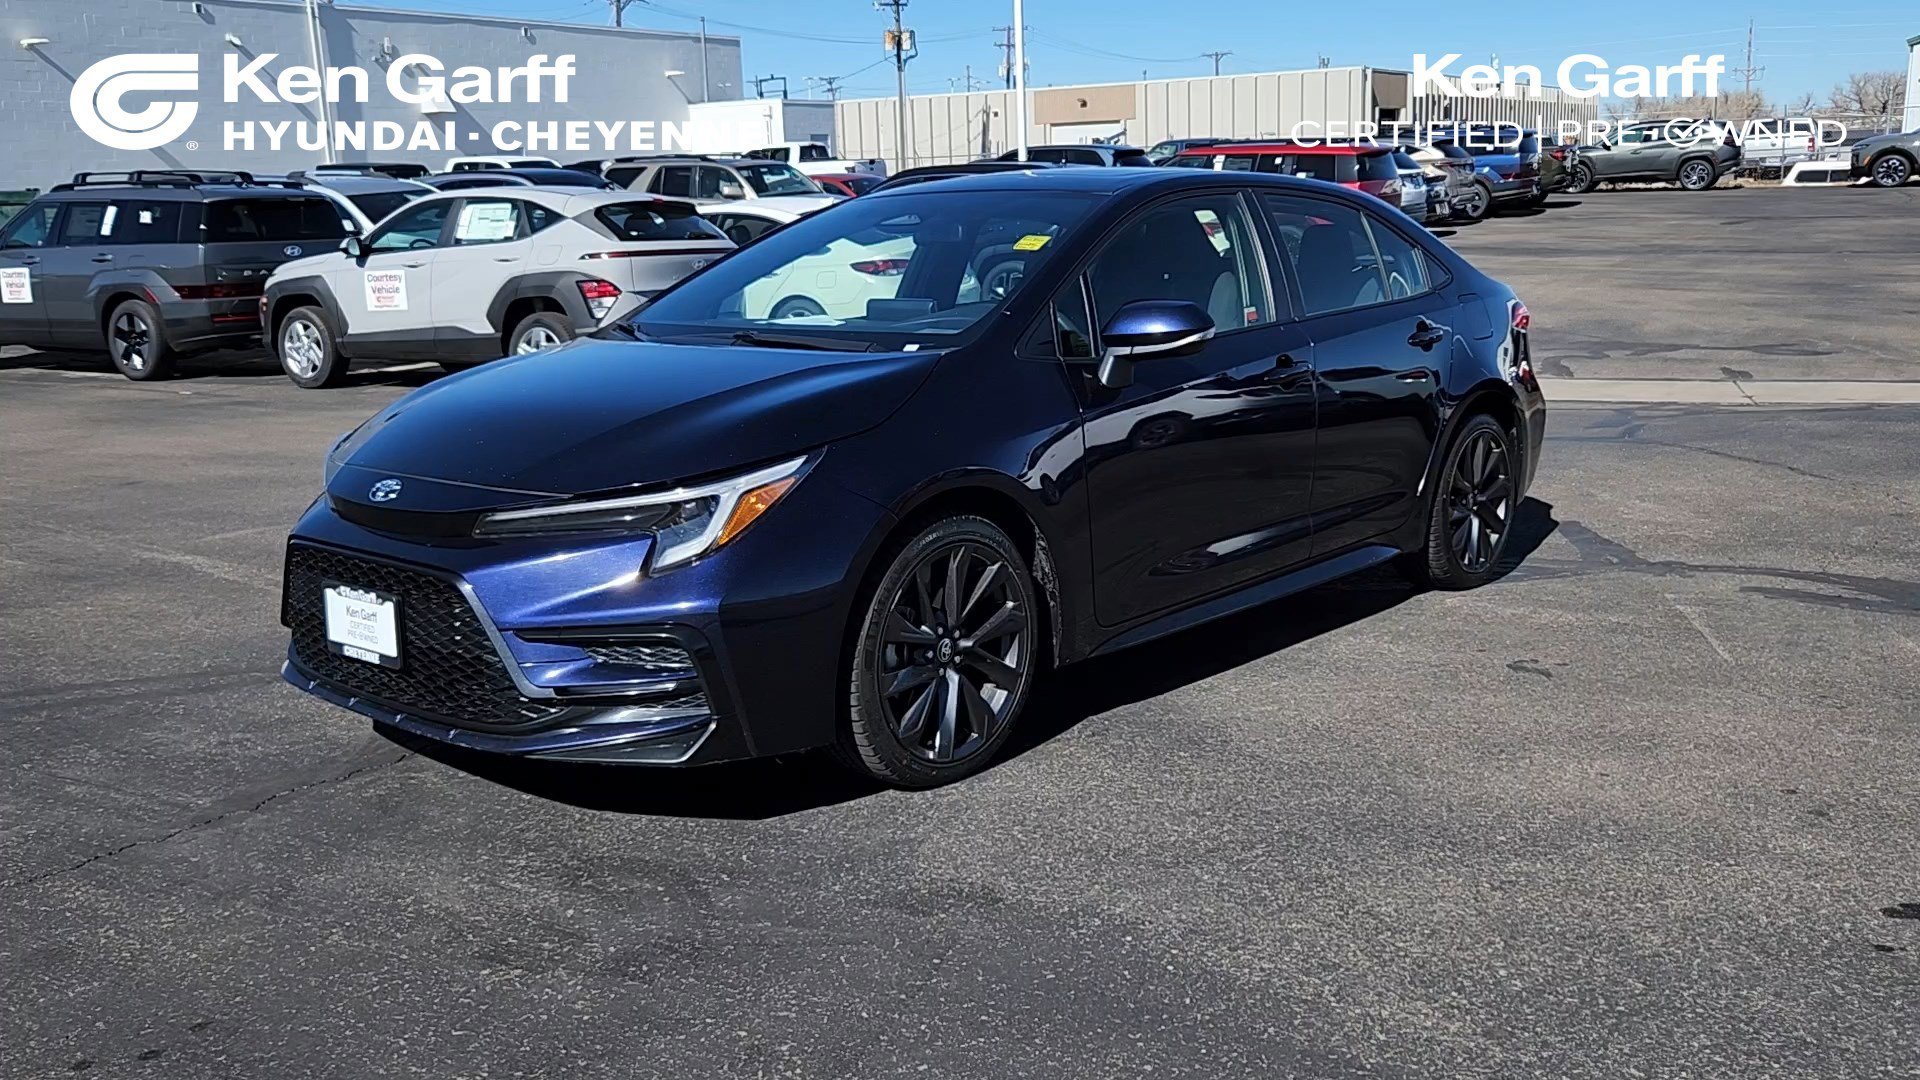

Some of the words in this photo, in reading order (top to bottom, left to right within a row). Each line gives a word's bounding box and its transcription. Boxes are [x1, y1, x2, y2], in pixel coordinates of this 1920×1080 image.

[367, 273, 402, 283] Courtesy
[371, 285, 401, 294] Vehicle
[345, 604, 361, 619] Ken
